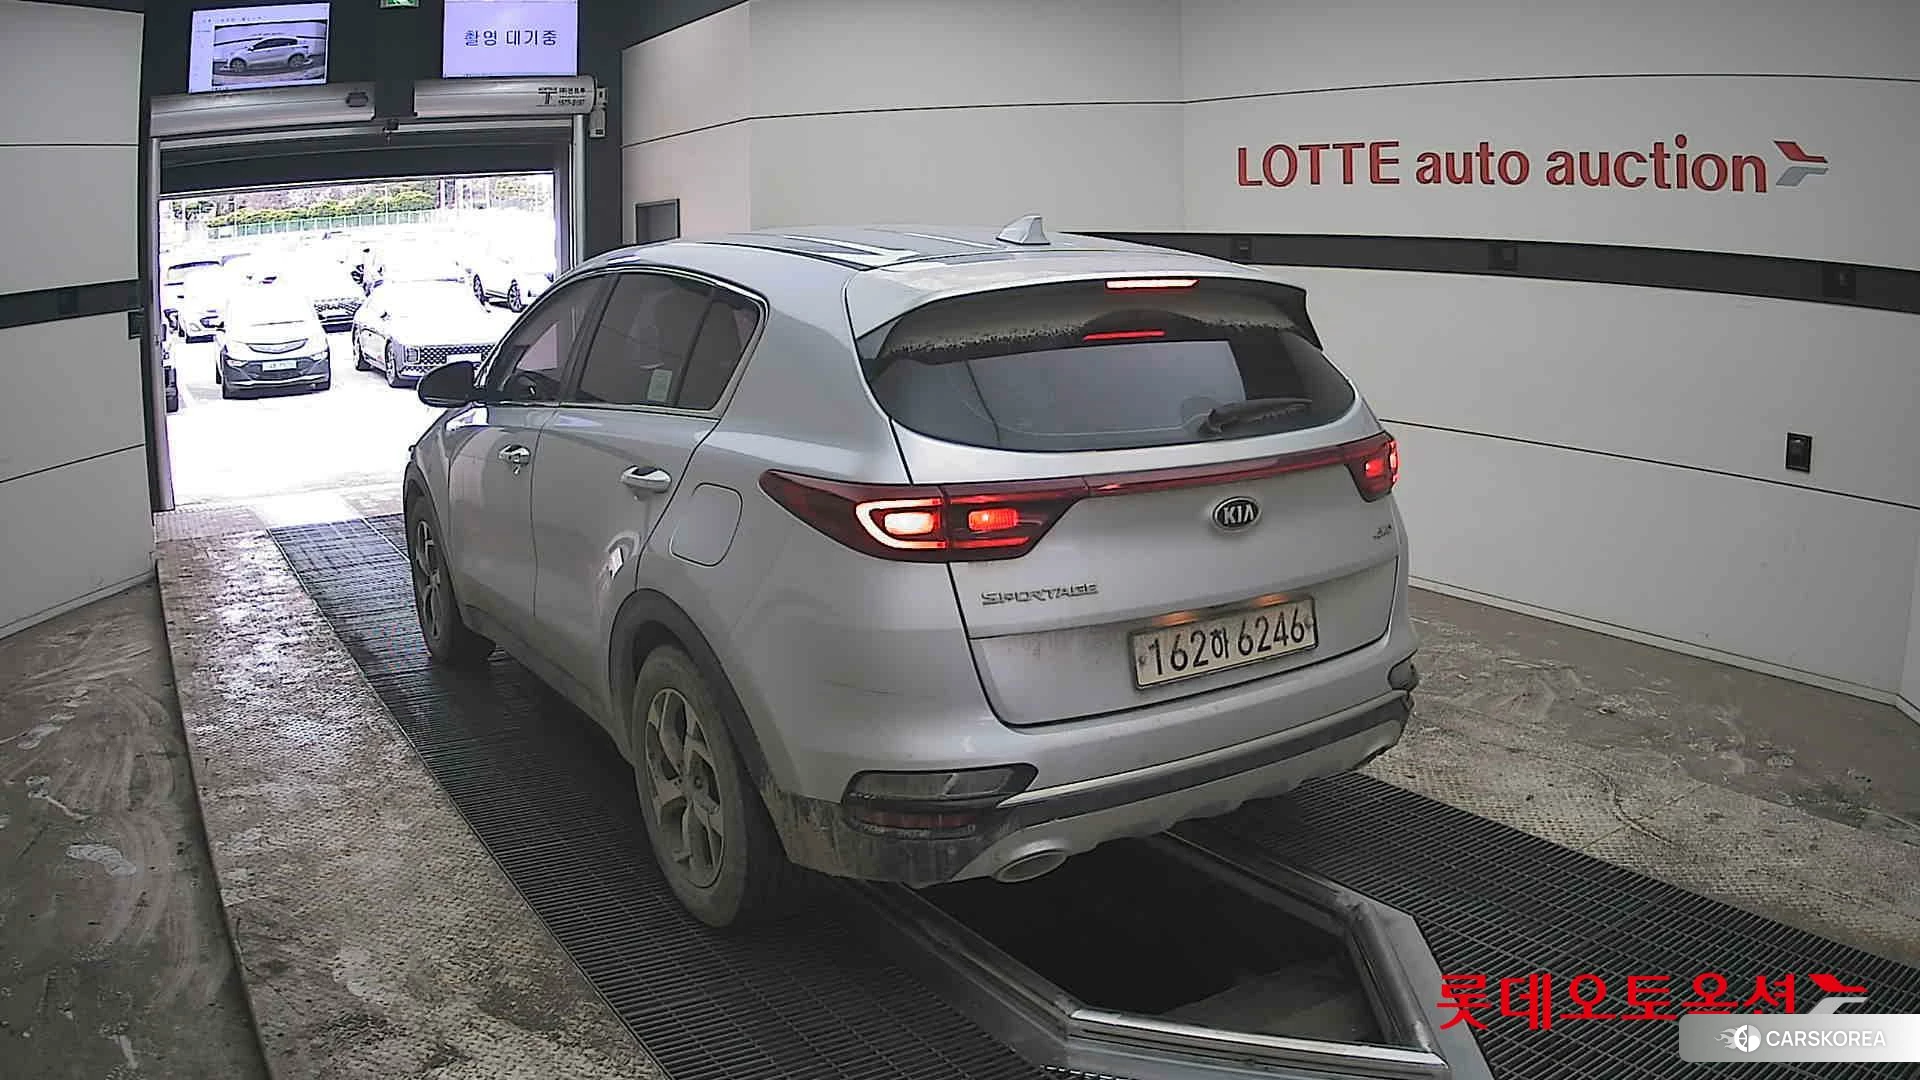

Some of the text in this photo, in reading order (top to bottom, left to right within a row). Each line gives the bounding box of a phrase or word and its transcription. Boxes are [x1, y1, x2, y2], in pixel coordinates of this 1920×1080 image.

[465, 30, 557, 46] 촬영 대기중
[1238, 134, 1767, 193] LOTTE auto auction
[1224, 505, 1254, 524] KIA
[981, 584, 1098, 606] SPORTAGE
[1150, 608, 1305, 675] 162하 6246
